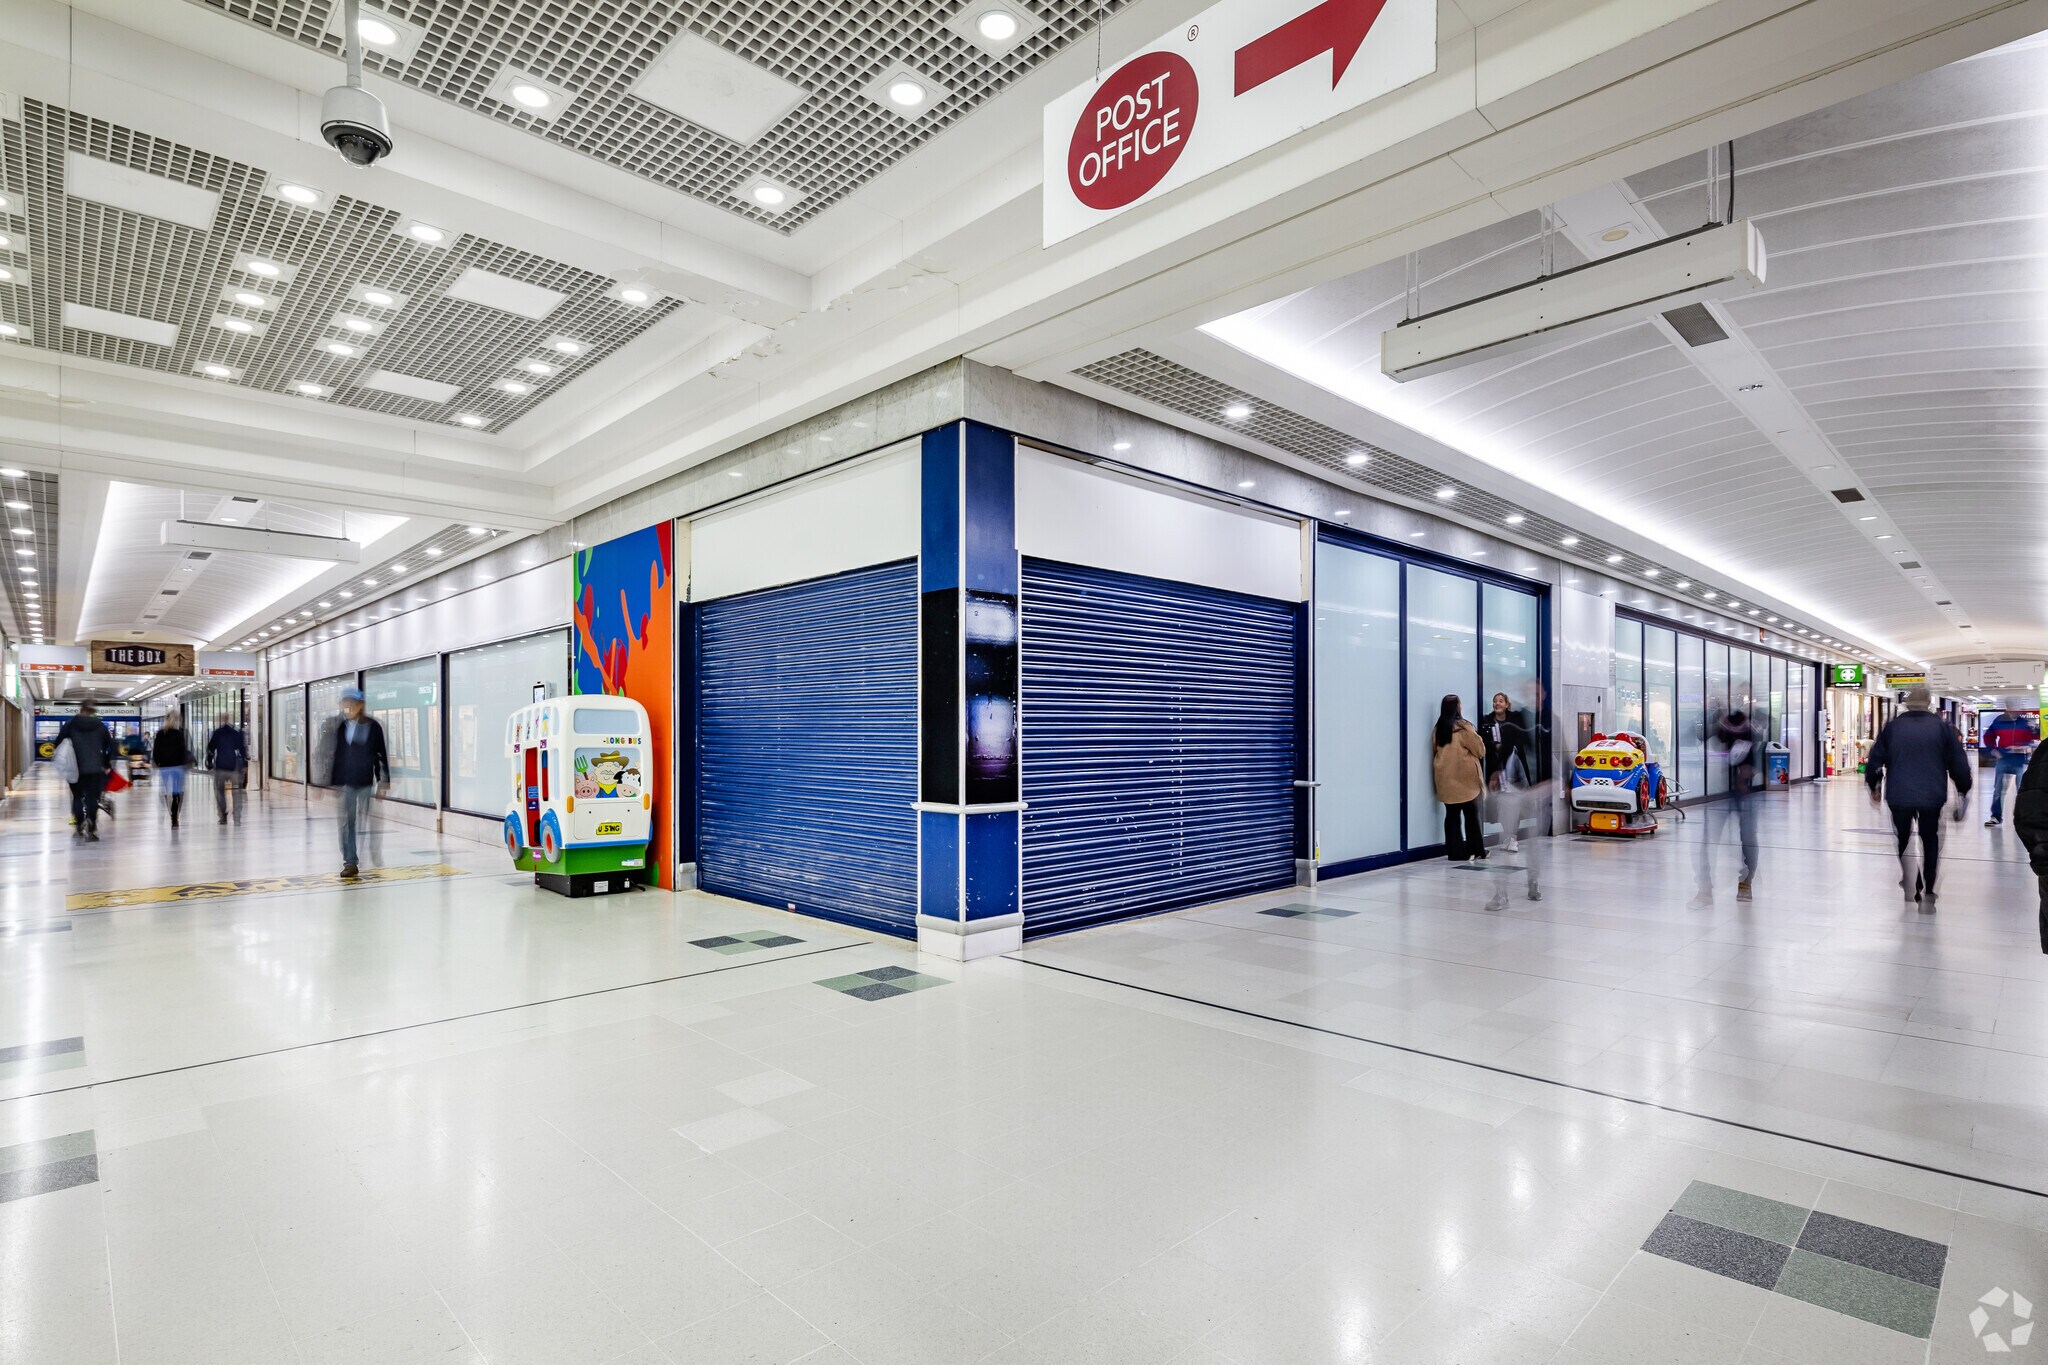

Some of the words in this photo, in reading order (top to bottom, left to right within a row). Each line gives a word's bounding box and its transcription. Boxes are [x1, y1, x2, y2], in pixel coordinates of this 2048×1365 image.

[1096, 72, 1171, 142] POST
[1078, 107, 1181, 187] OFFICE
[110, 649, 134, 663] THE
[138, 650, 161, 663] BOX
[628, 737, 641, 745] BUS
